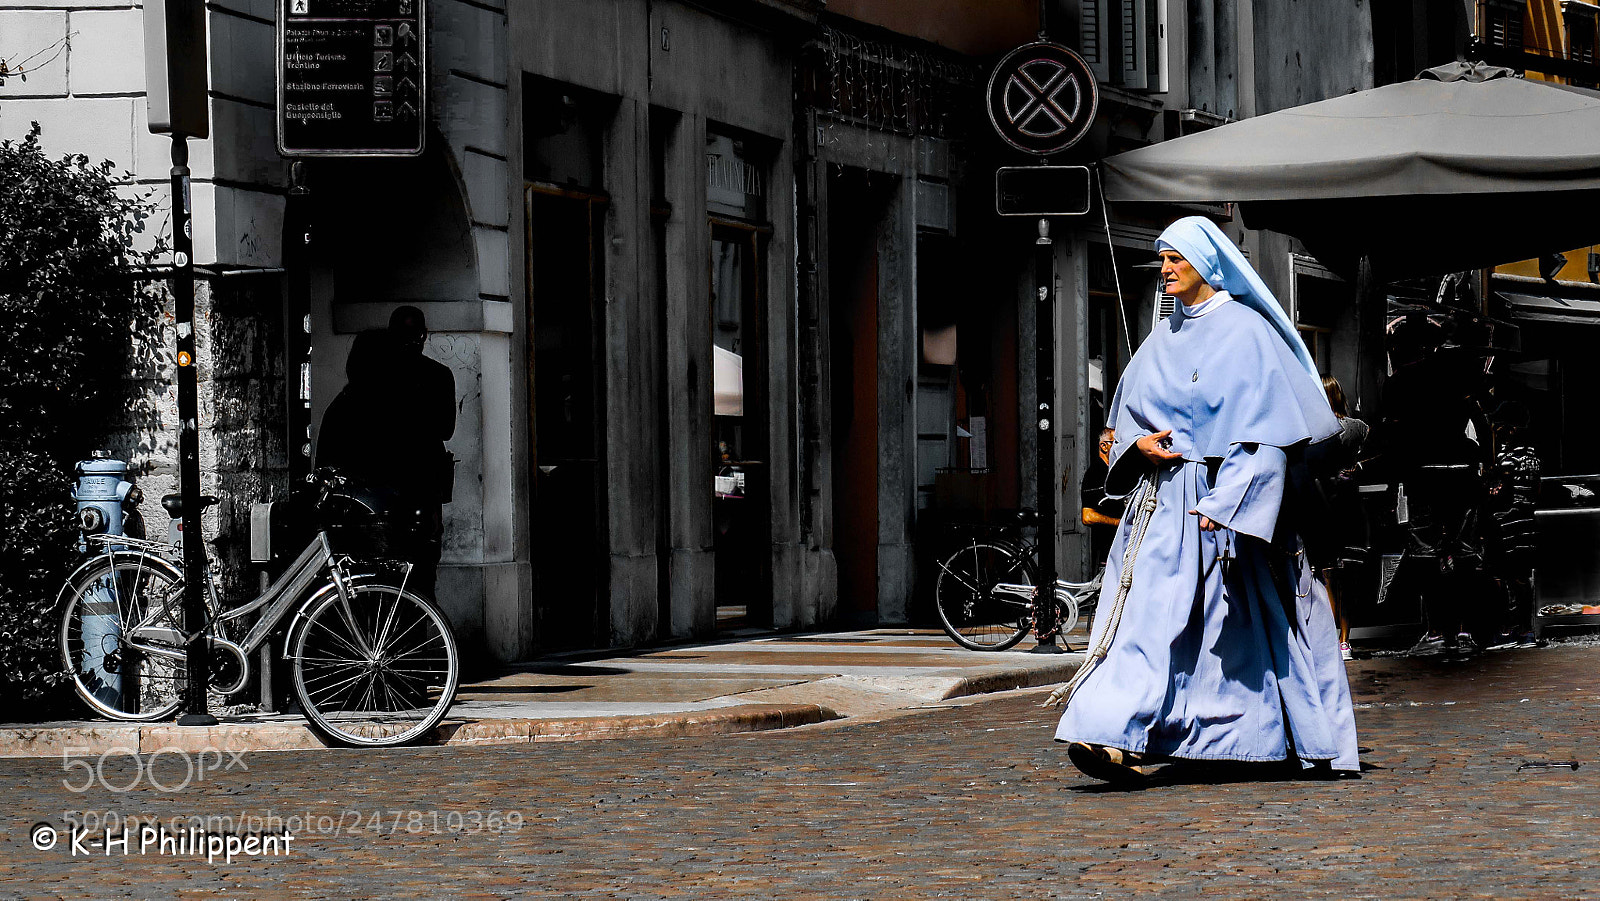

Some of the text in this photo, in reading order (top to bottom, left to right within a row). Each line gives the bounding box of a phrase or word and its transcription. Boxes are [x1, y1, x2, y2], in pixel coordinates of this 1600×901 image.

[315, 53, 347, 61] Turismo
[286, 103, 334, 111] Castello del
[286, 112, 342, 120] Buonconsiglio
